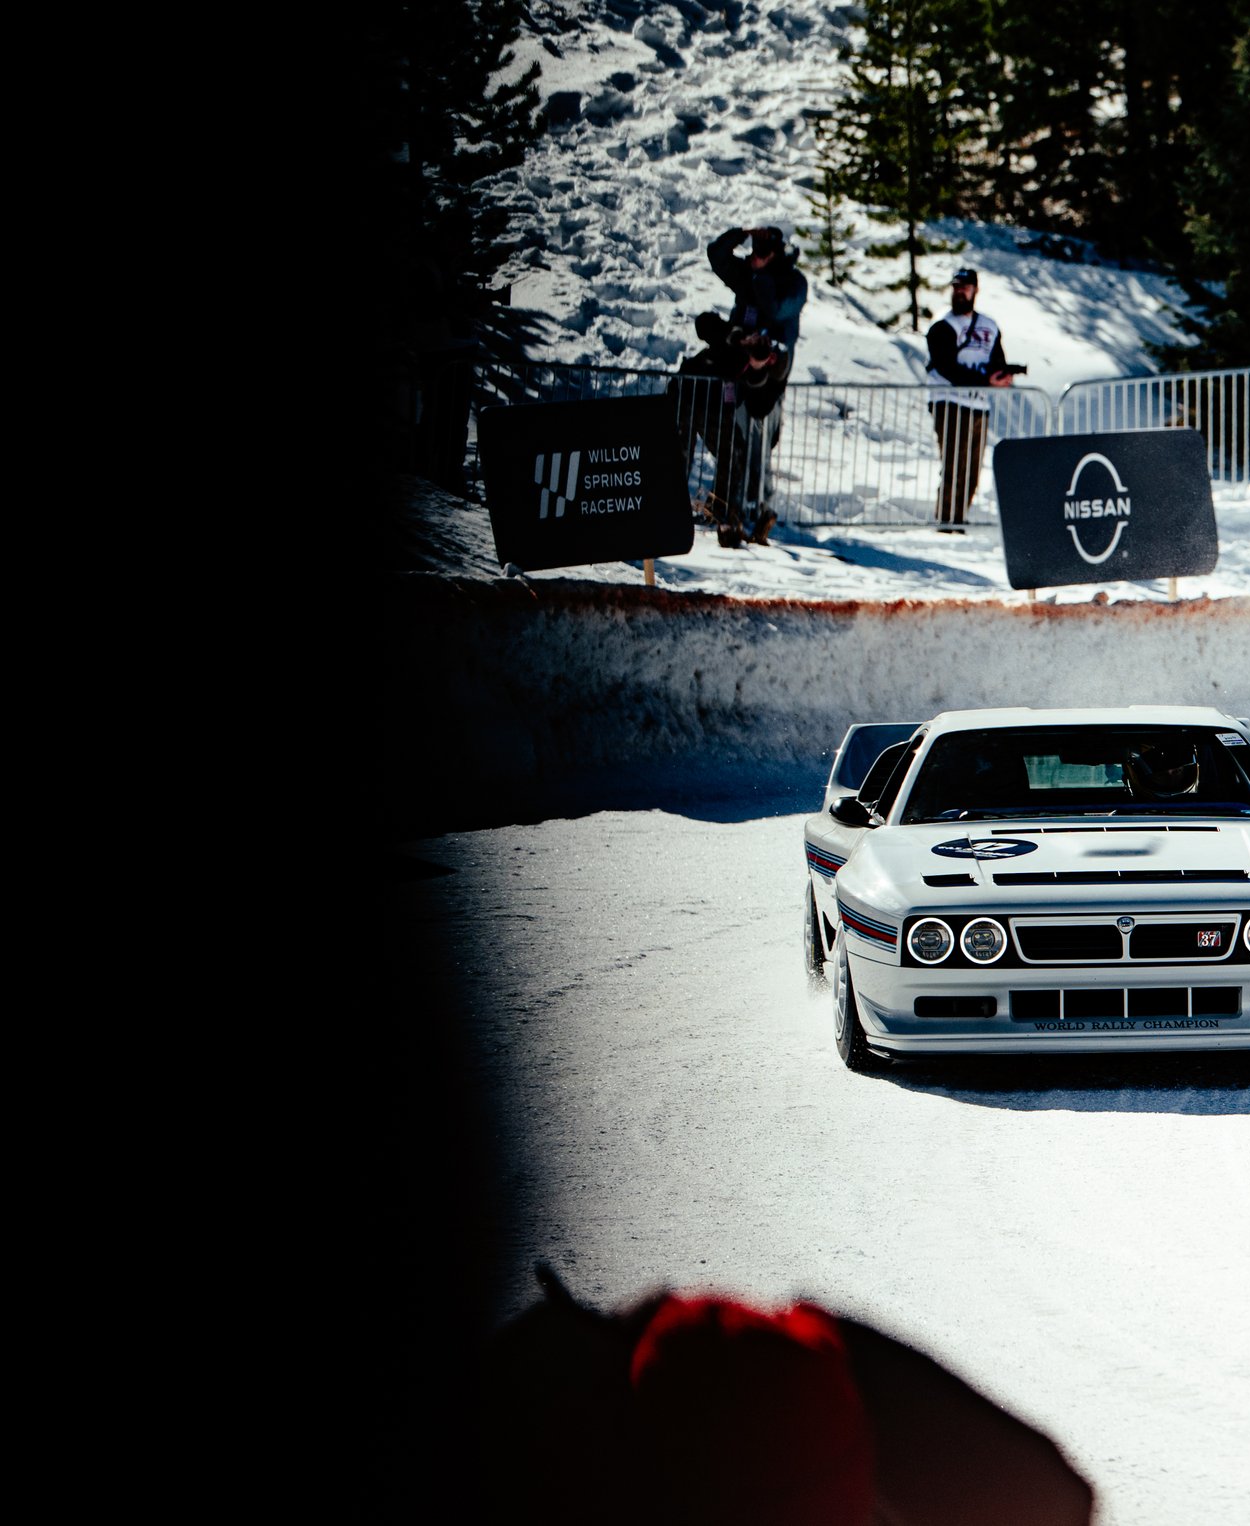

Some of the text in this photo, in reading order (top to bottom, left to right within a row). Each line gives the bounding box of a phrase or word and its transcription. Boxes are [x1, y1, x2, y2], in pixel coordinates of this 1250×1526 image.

[588, 446, 641, 463] WILLOW
[584, 471, 642, 490] SPRINGS
[581, 496, 643, 515] RACEWAY
[1064, 497, 1131, 520] NISSAN
[1201, 934, 1217, 946] 37
[1035, 1018, 1220, 1031] WORLD RALLY CHAMPION
